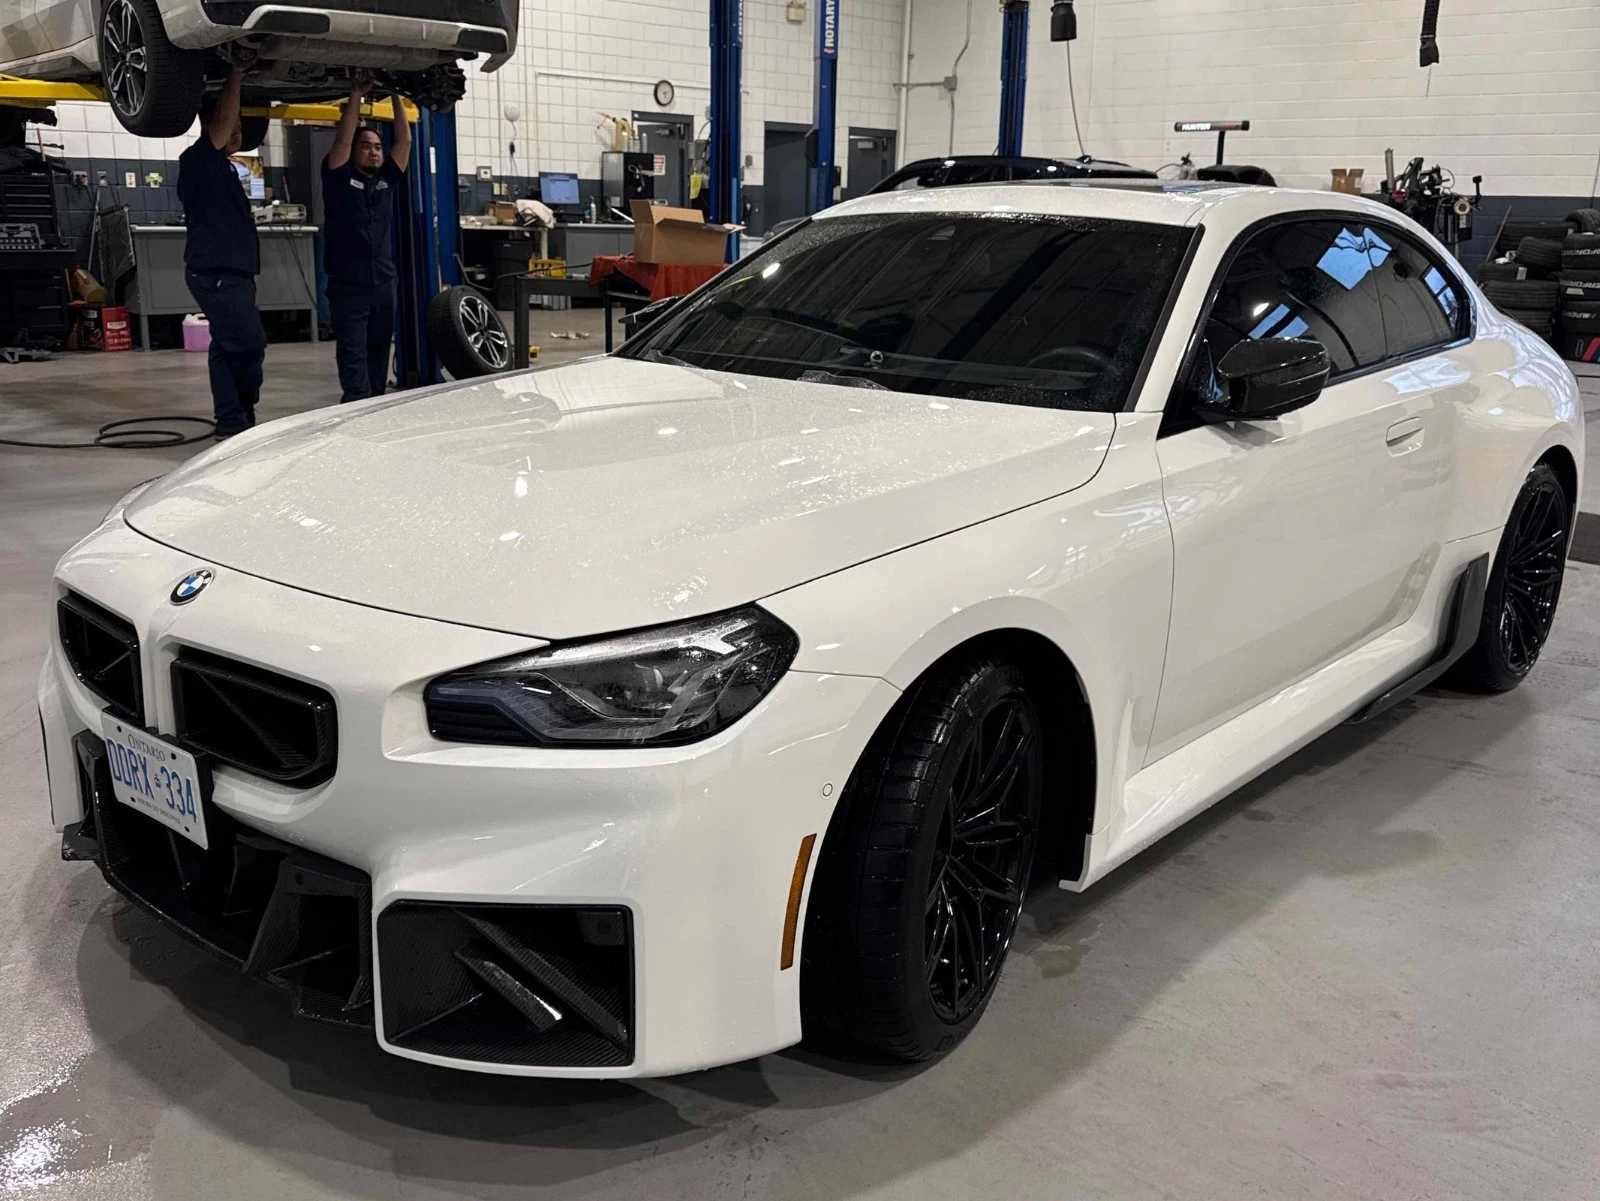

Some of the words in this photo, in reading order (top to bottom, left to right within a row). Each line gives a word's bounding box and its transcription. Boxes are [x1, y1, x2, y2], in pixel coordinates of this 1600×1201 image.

[825, 0, 835, 47] ROTARY
[128, 734, 165, 761] ONTARIO
[106, 738, 155, 800] DDRX
[160, 765, 197, 824] 334
